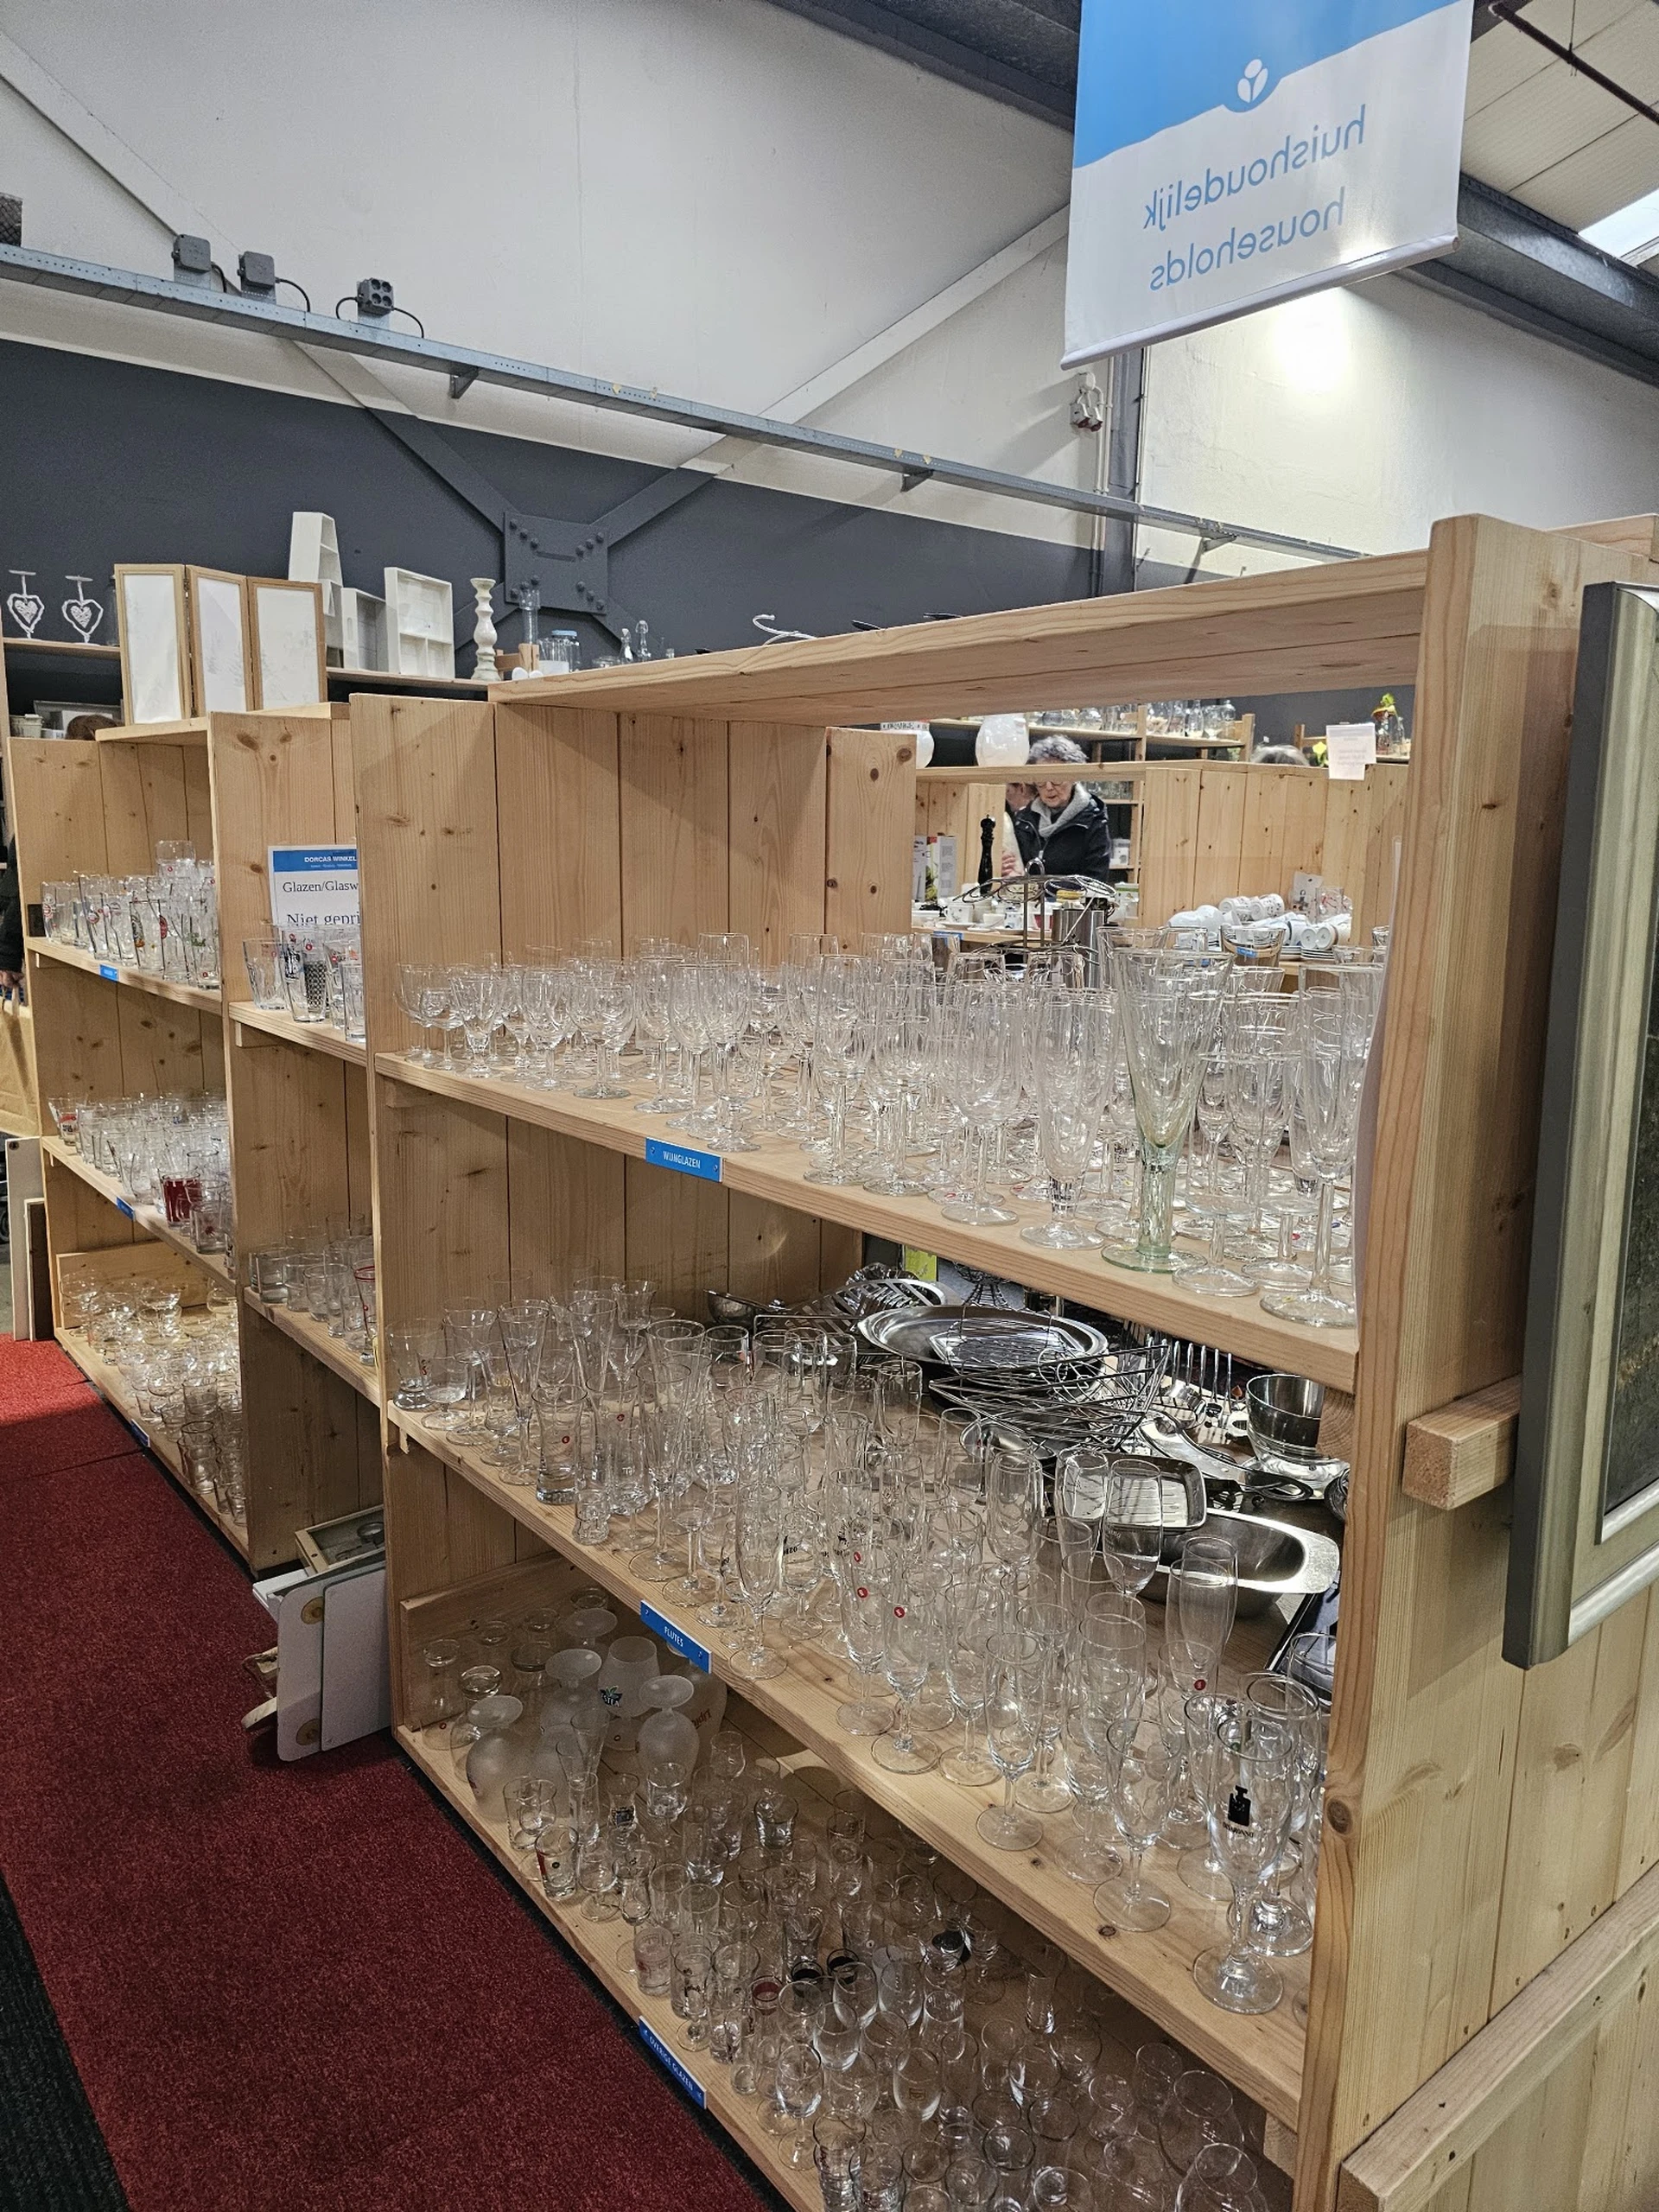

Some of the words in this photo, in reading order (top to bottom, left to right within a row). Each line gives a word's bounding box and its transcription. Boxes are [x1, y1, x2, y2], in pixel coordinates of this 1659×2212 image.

[287, 913, 319, 926] Niet
[663, 1150, 701, 1169] WIJNGLAZEN
[664, 1625, 683, 1648] FLUTES
[649, 2036, 671, 2066] OVERIGE
[672, 2063, 694, 2091] GLAZEN
